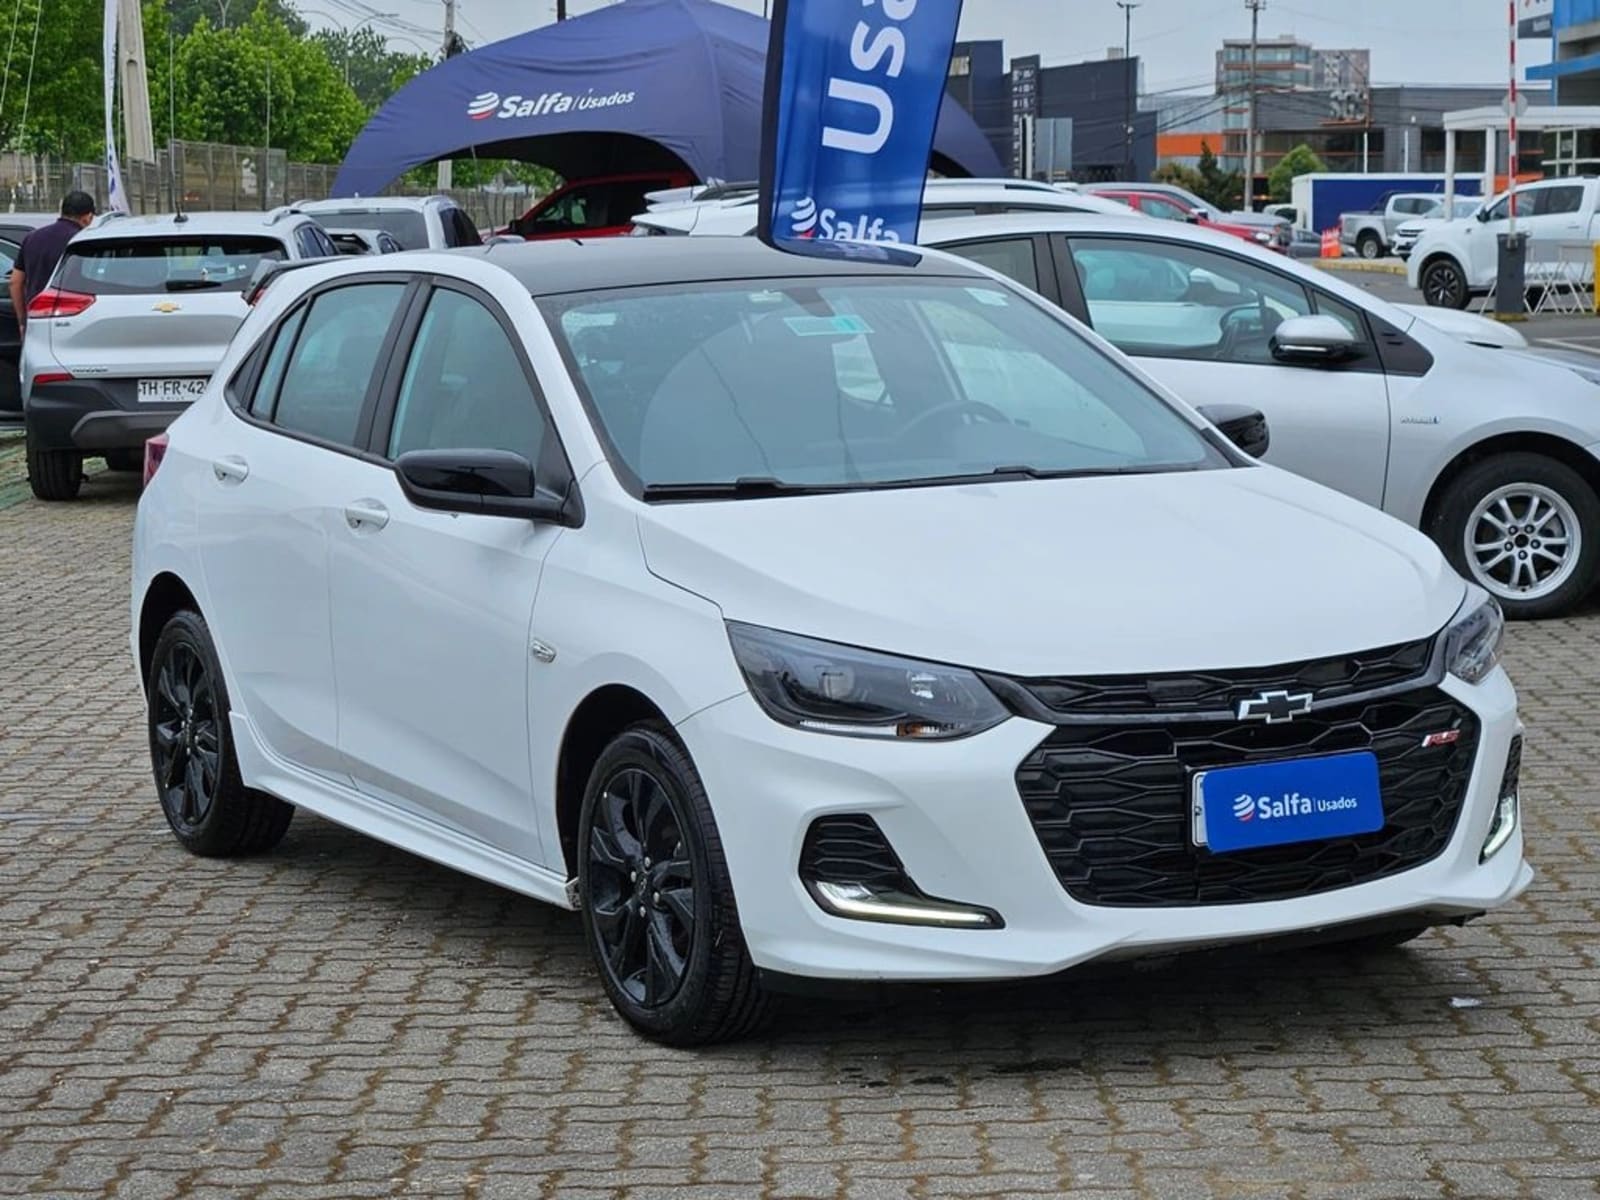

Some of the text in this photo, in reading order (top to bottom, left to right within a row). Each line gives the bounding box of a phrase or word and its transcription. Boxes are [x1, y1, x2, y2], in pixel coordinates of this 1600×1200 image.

[497, 92, 574, 119] Salfa
[1257, 792, 1358, 820] Salfa Usados
